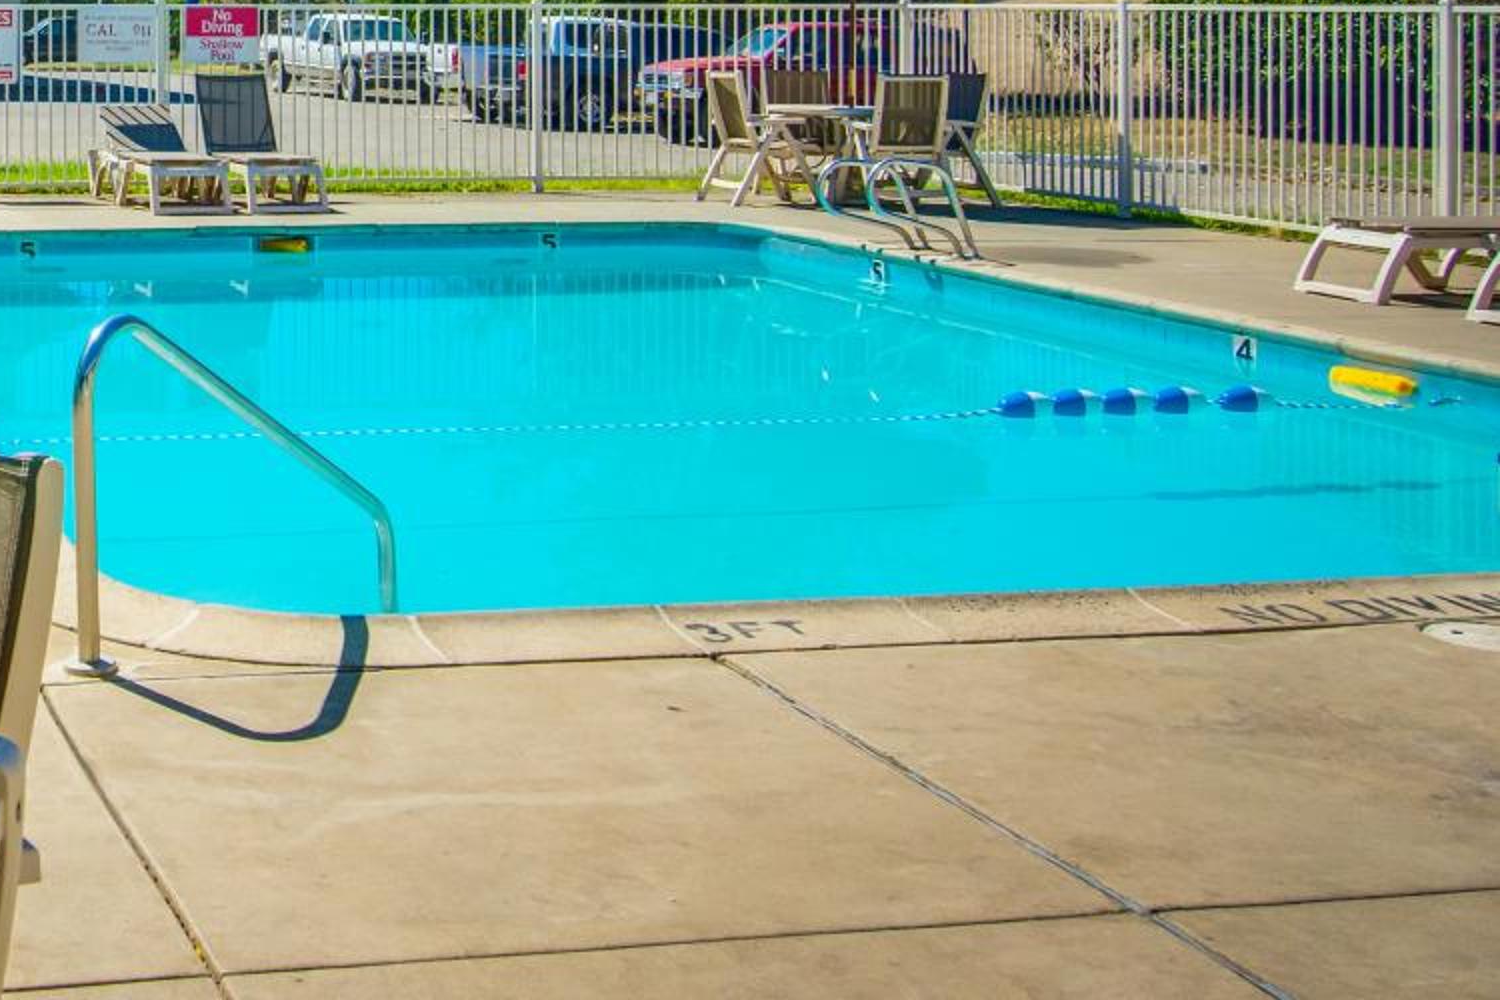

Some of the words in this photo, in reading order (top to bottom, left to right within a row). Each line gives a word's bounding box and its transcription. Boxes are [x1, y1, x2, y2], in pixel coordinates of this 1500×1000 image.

[212, 8, 232, 21] No
[201, 20, 244, 37] Diving
[20, 241, 36, 258] 5
[541, 233, 557, 249] 5
[1235, 338, 1253, 361] 4
[1219, 602, 1329, 625] NO
